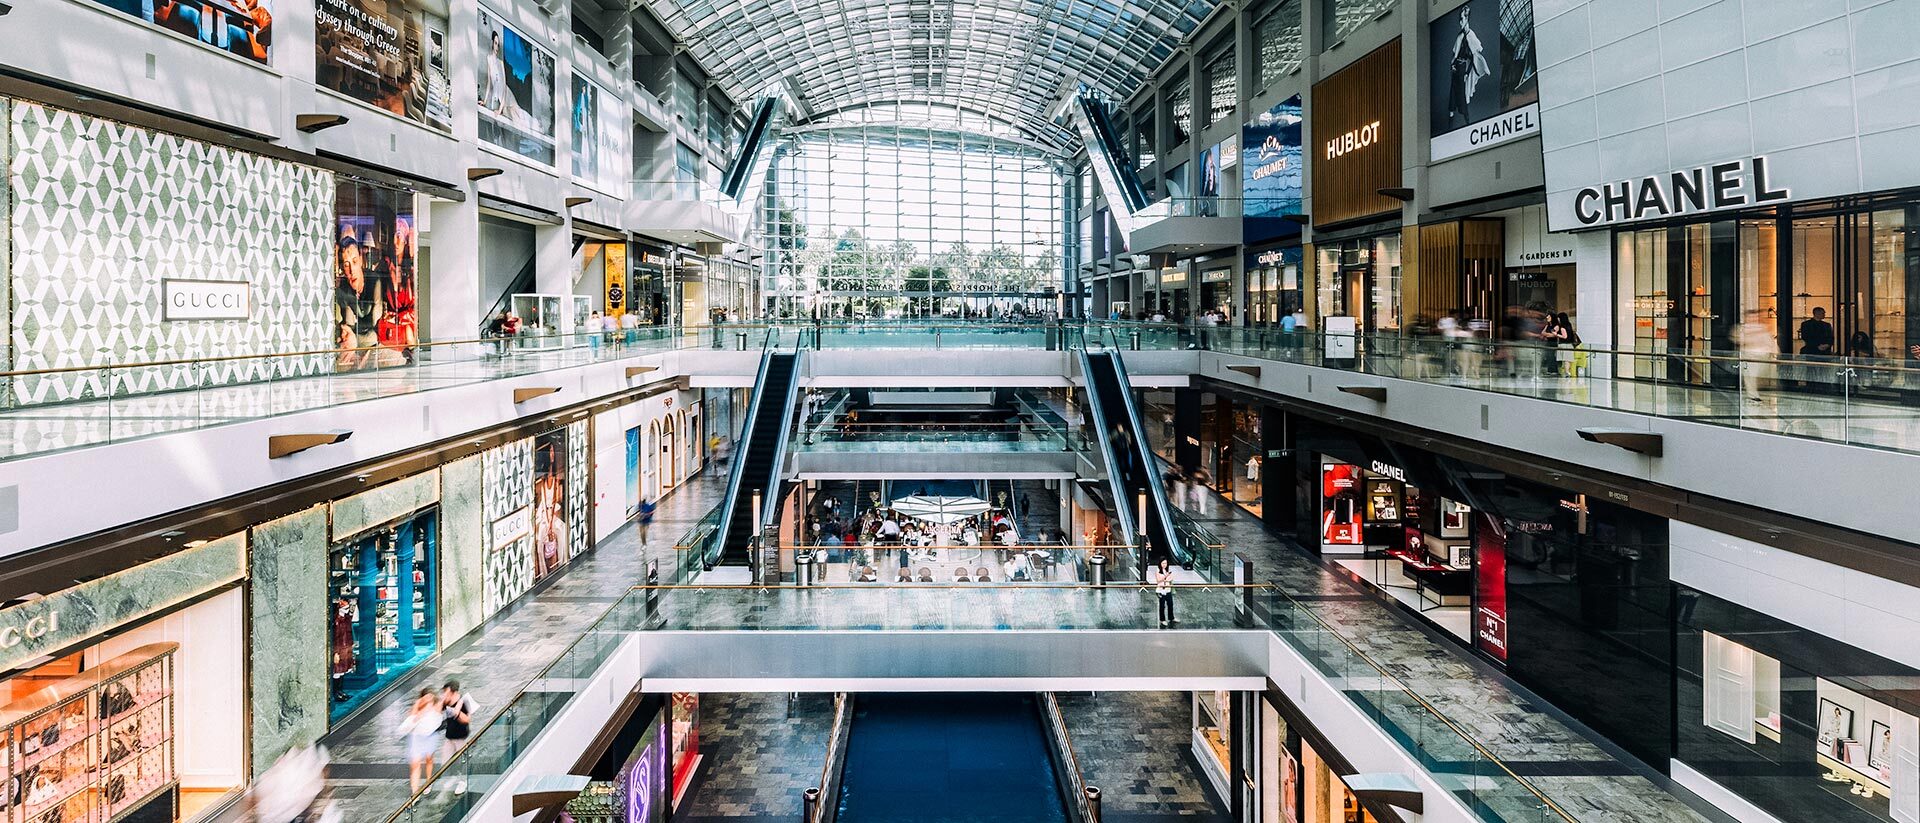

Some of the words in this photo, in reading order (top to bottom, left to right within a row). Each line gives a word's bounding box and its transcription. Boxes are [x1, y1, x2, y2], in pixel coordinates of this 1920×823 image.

[350, 7, 360, 18] on
[361, 12, 367, 22] a
[368, 15, 398, 40] culinary
[344, 19, 374, 47] through
[376, 34, 401, 57] Greece
[1326, 120, 1380, 160] HUBLOT
[1470, 111, 1534, 146] CHANEL
[1253, 156, 1290, 180] CHAUMET
[1575, 156, 1790, 225] CHANEL
[1526, 251, 1560, 260] GARDENS
[1563, 249, 1573, 257] BY
[174, 291, 240, 309] GUCCI
[1372, 460, 1407, 482] CHANEL
[495, 513, 525, 541] GUCCI
[1480, 630, 1505, 650] CHANEL
